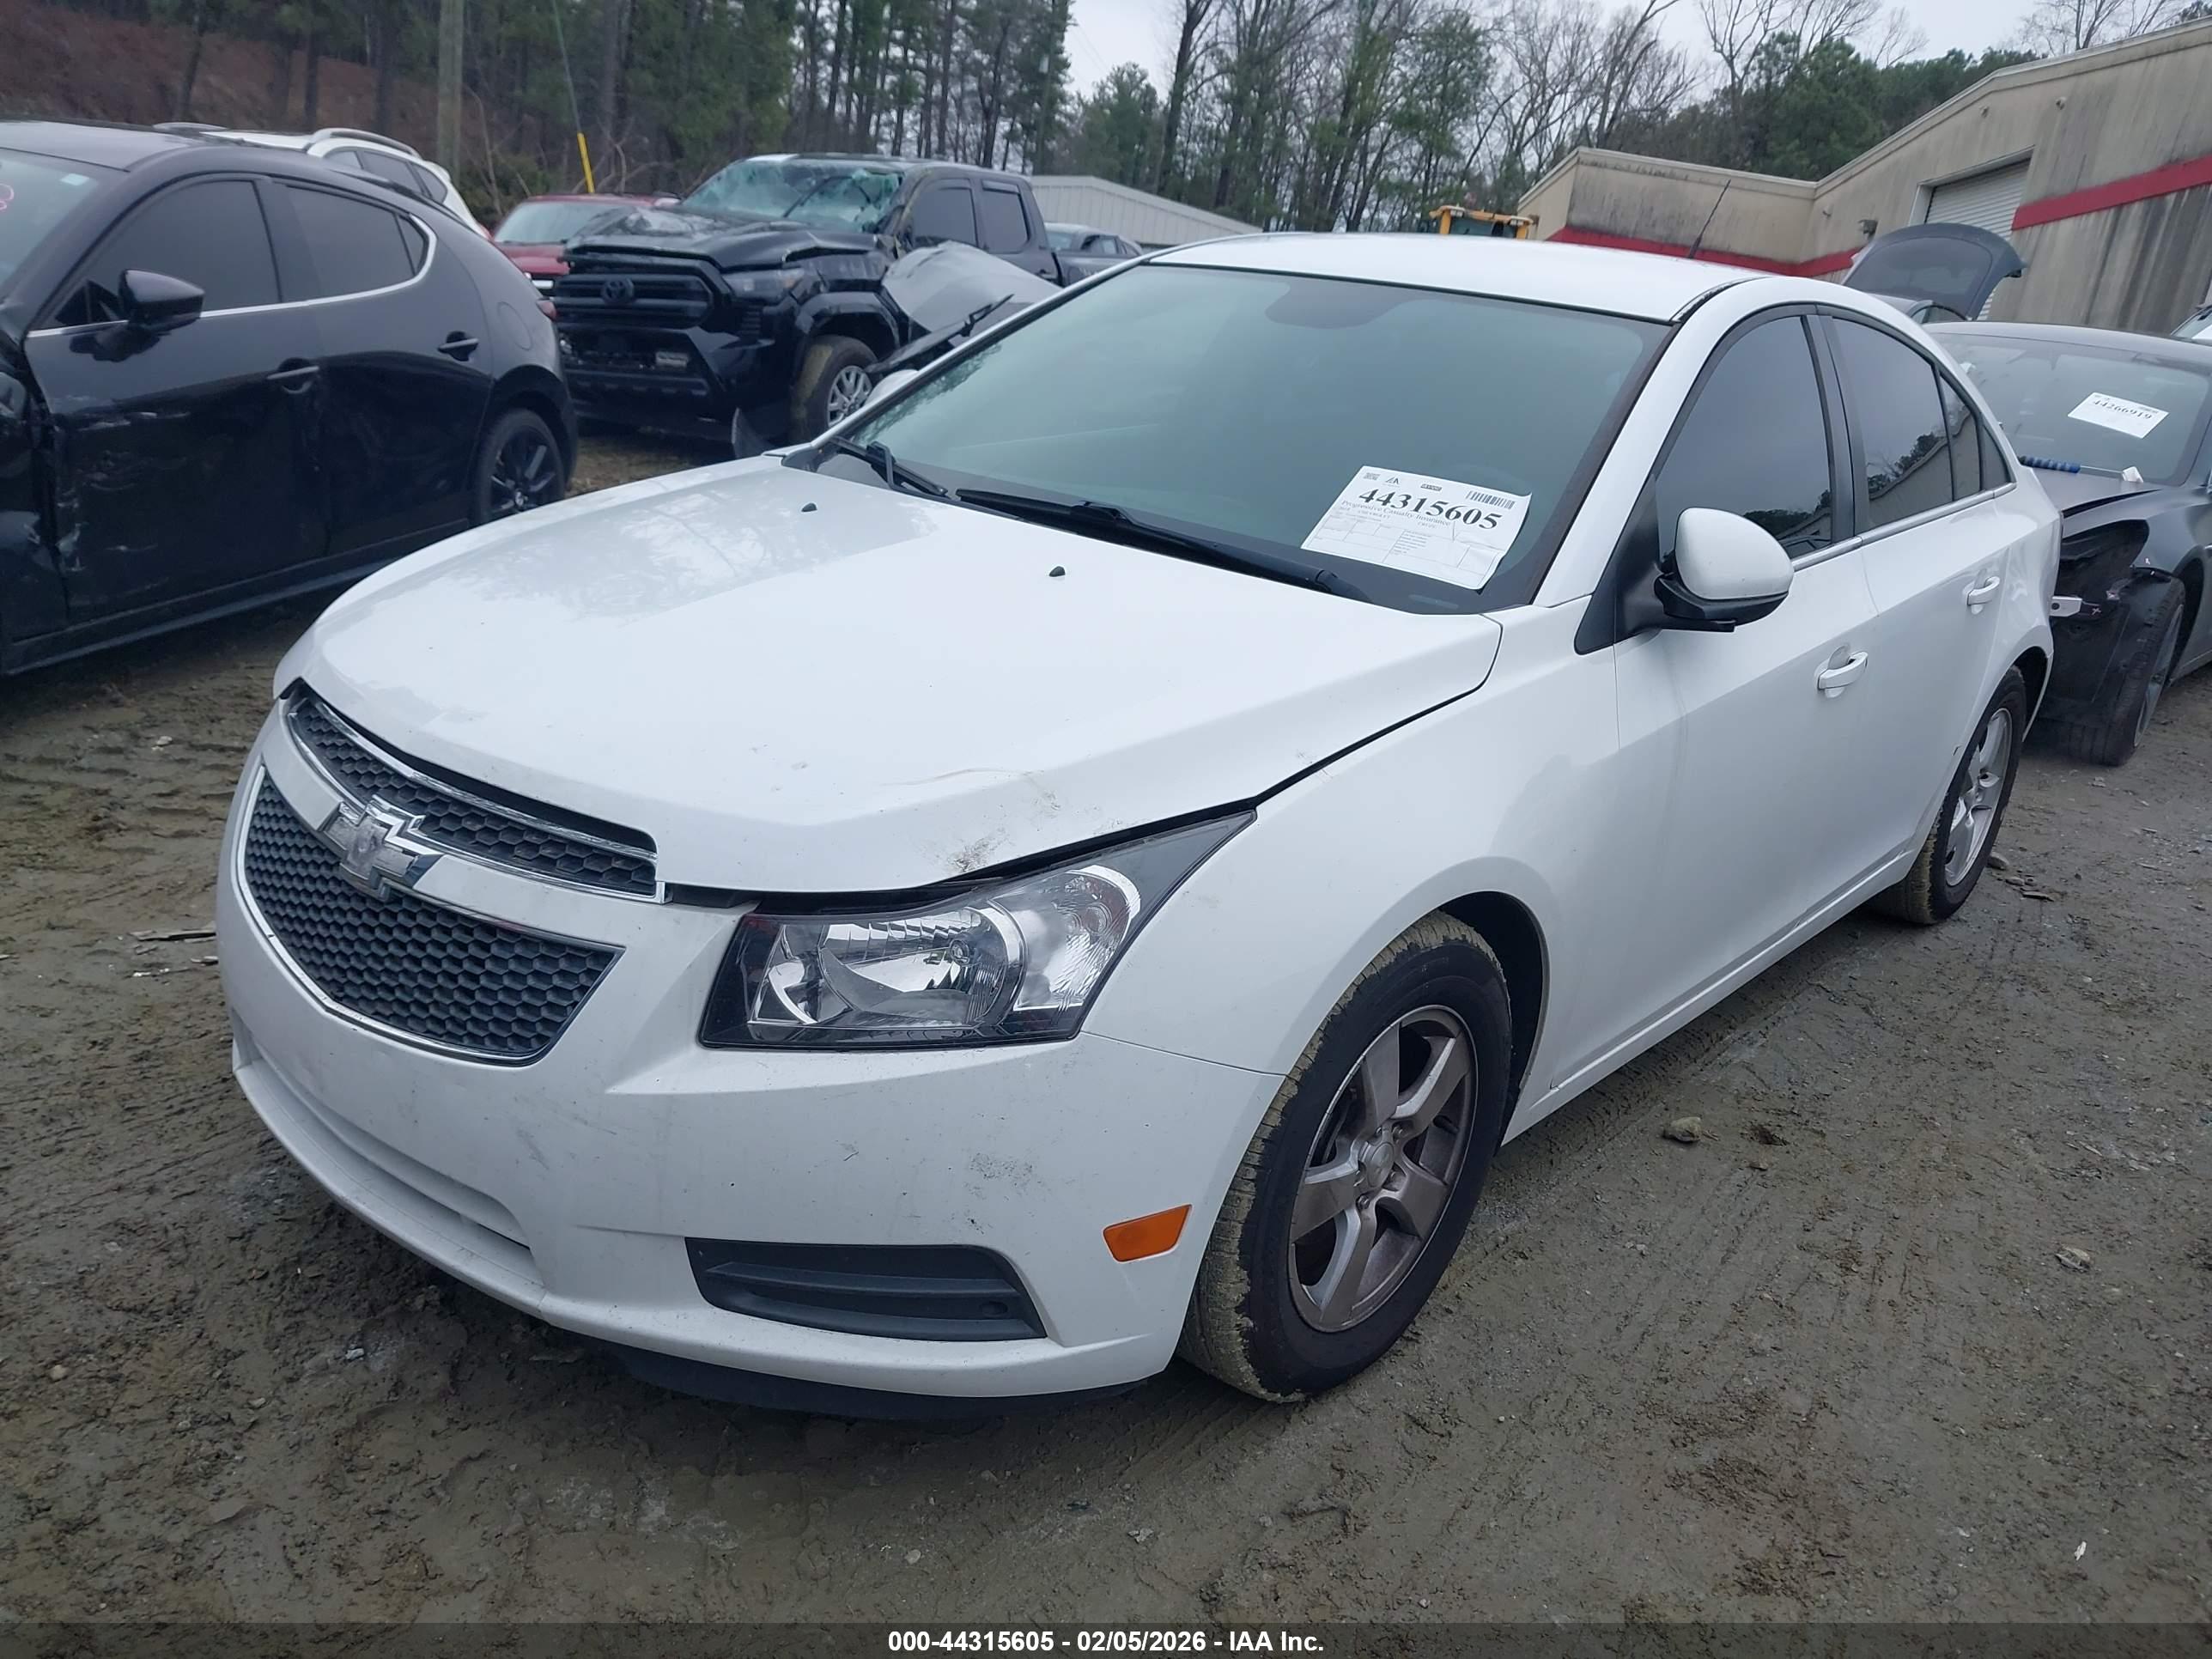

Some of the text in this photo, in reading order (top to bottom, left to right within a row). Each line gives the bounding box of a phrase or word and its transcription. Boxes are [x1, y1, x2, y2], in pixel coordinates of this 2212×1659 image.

[2093, 399, 2153, 419] 44266919
[1340, 500, 1382, 513] Progressive
[1382, 506, 1414, 519] Casualty
[1415, 514, 1451, 526] Insurance
[1358, 488, 1503, 530] 44315605
